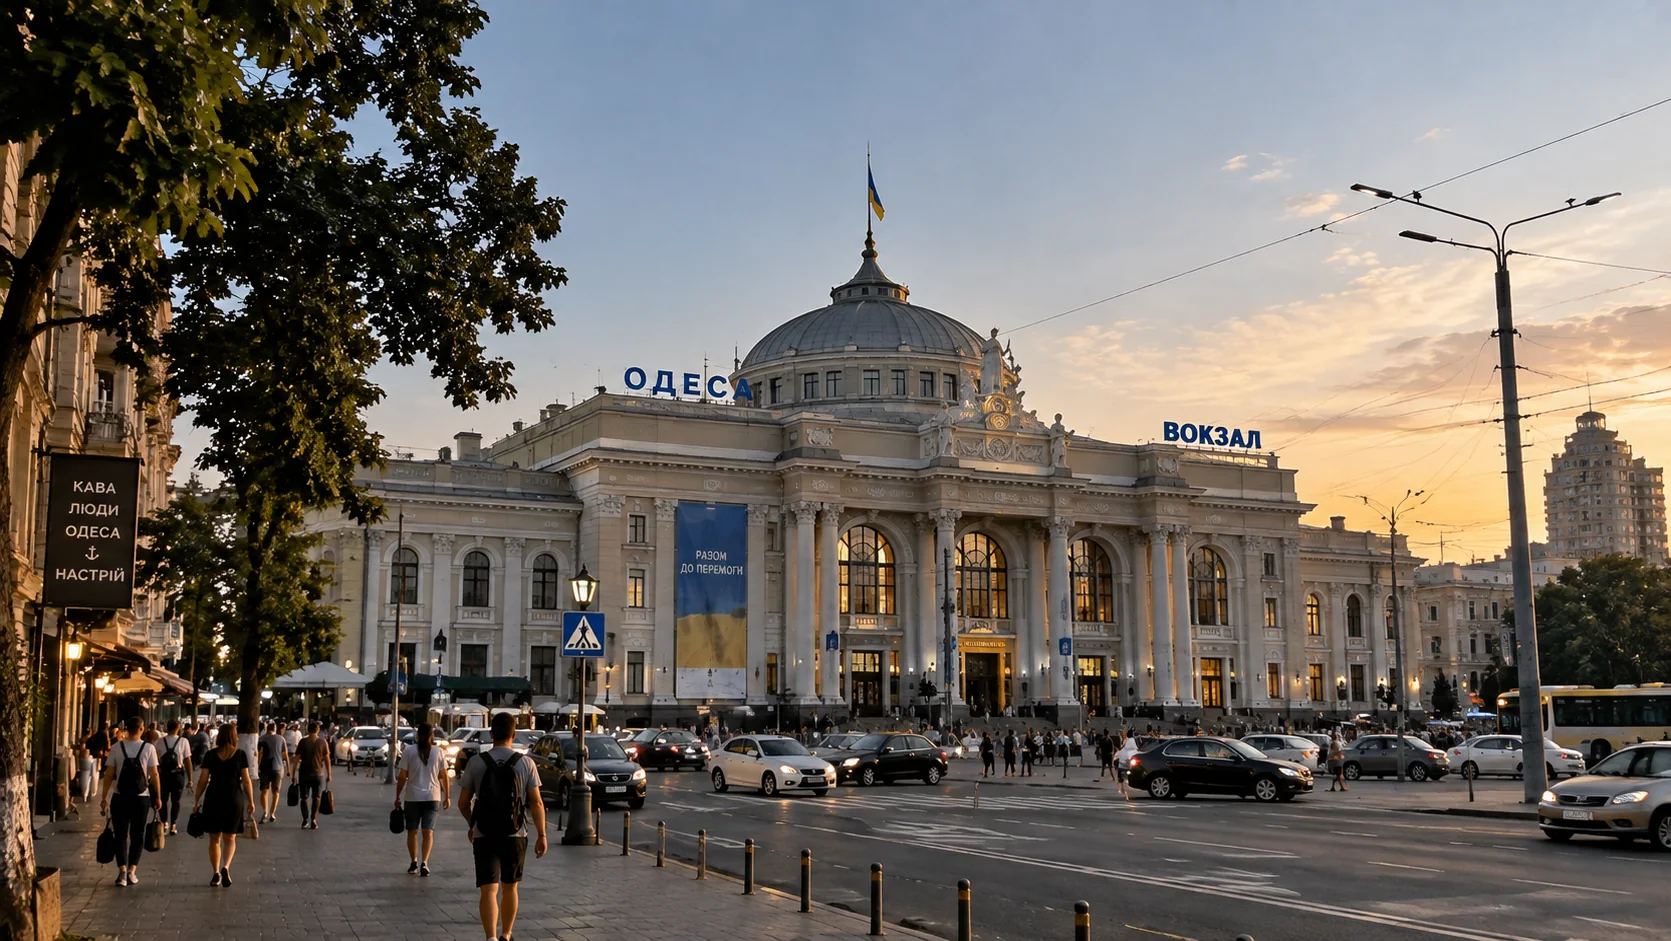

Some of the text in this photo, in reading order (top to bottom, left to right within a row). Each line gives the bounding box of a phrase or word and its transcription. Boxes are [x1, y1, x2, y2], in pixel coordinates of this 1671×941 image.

[624, 366, 753, 401] ОДЕСА
[1163, 421, 1262, 449] ВОКЗАЛ
[73, 480, 117, 494] КАВА
[68, 502, 119, 517] ЛЮДИ
[65, 525, 121, 539] ОДЕСА
[55, 567, 125, 582] НАСТРІЙ
[680, 563, 694, 575] ДО
